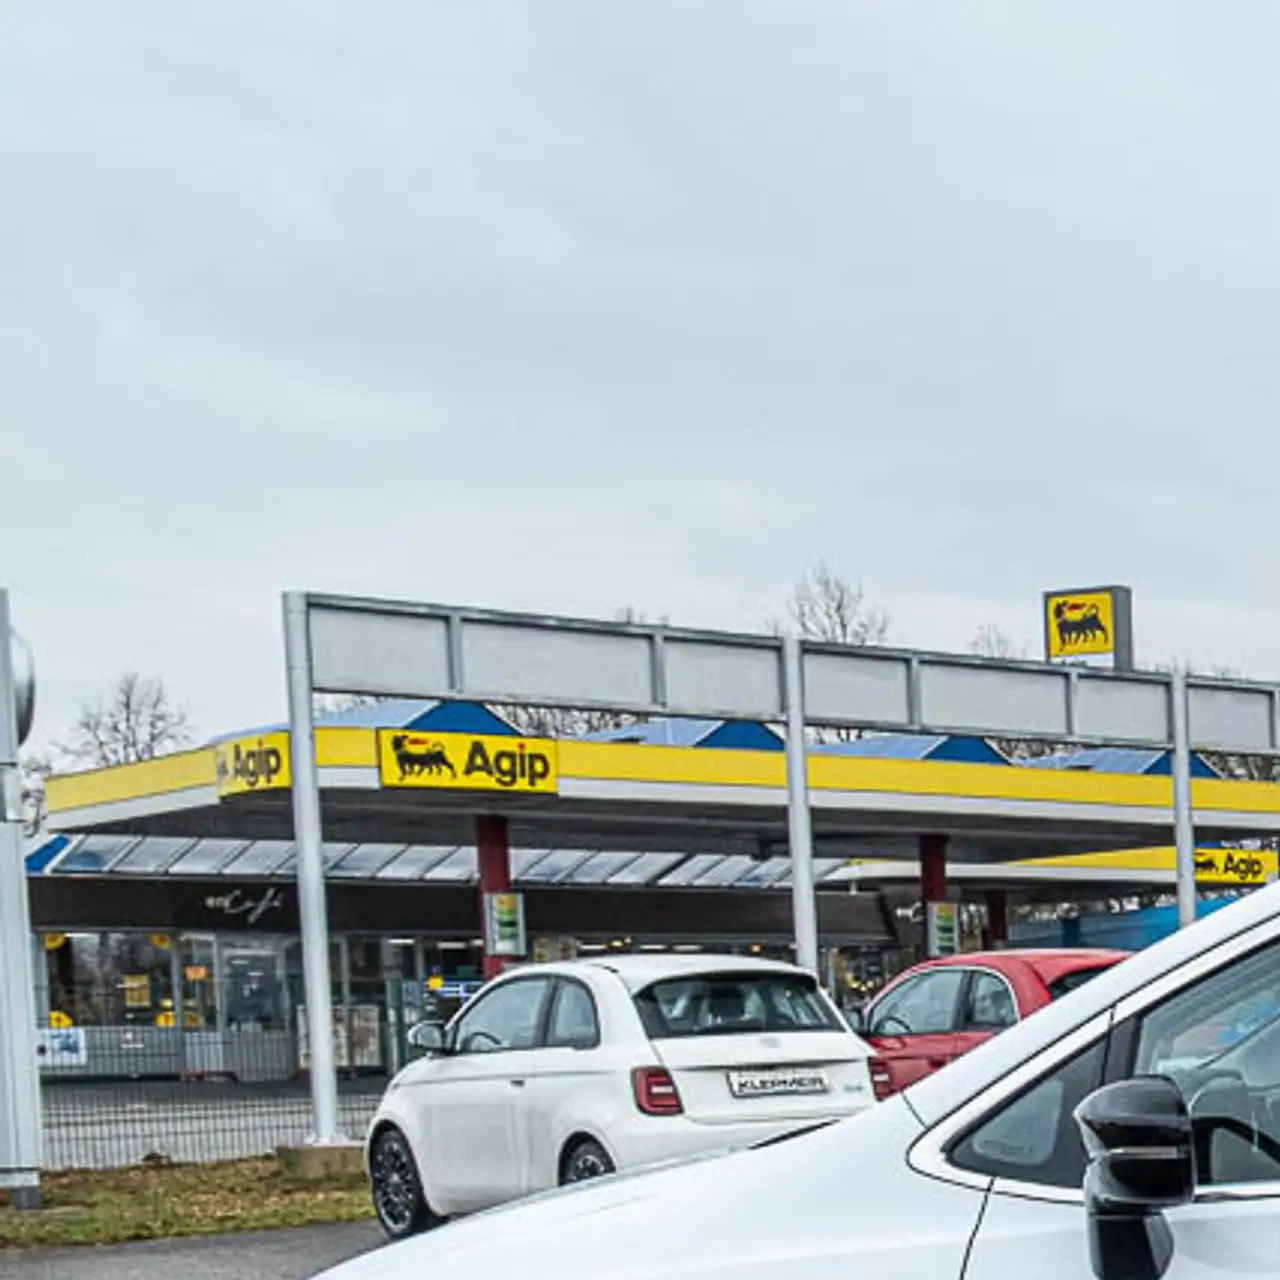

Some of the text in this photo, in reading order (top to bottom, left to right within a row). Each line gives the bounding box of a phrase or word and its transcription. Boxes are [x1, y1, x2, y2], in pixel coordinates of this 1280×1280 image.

[233, 738, 282, 787] Agip
[463, 740, 550, 787] Agip
[1223, 851, 1263, 880] Agip
